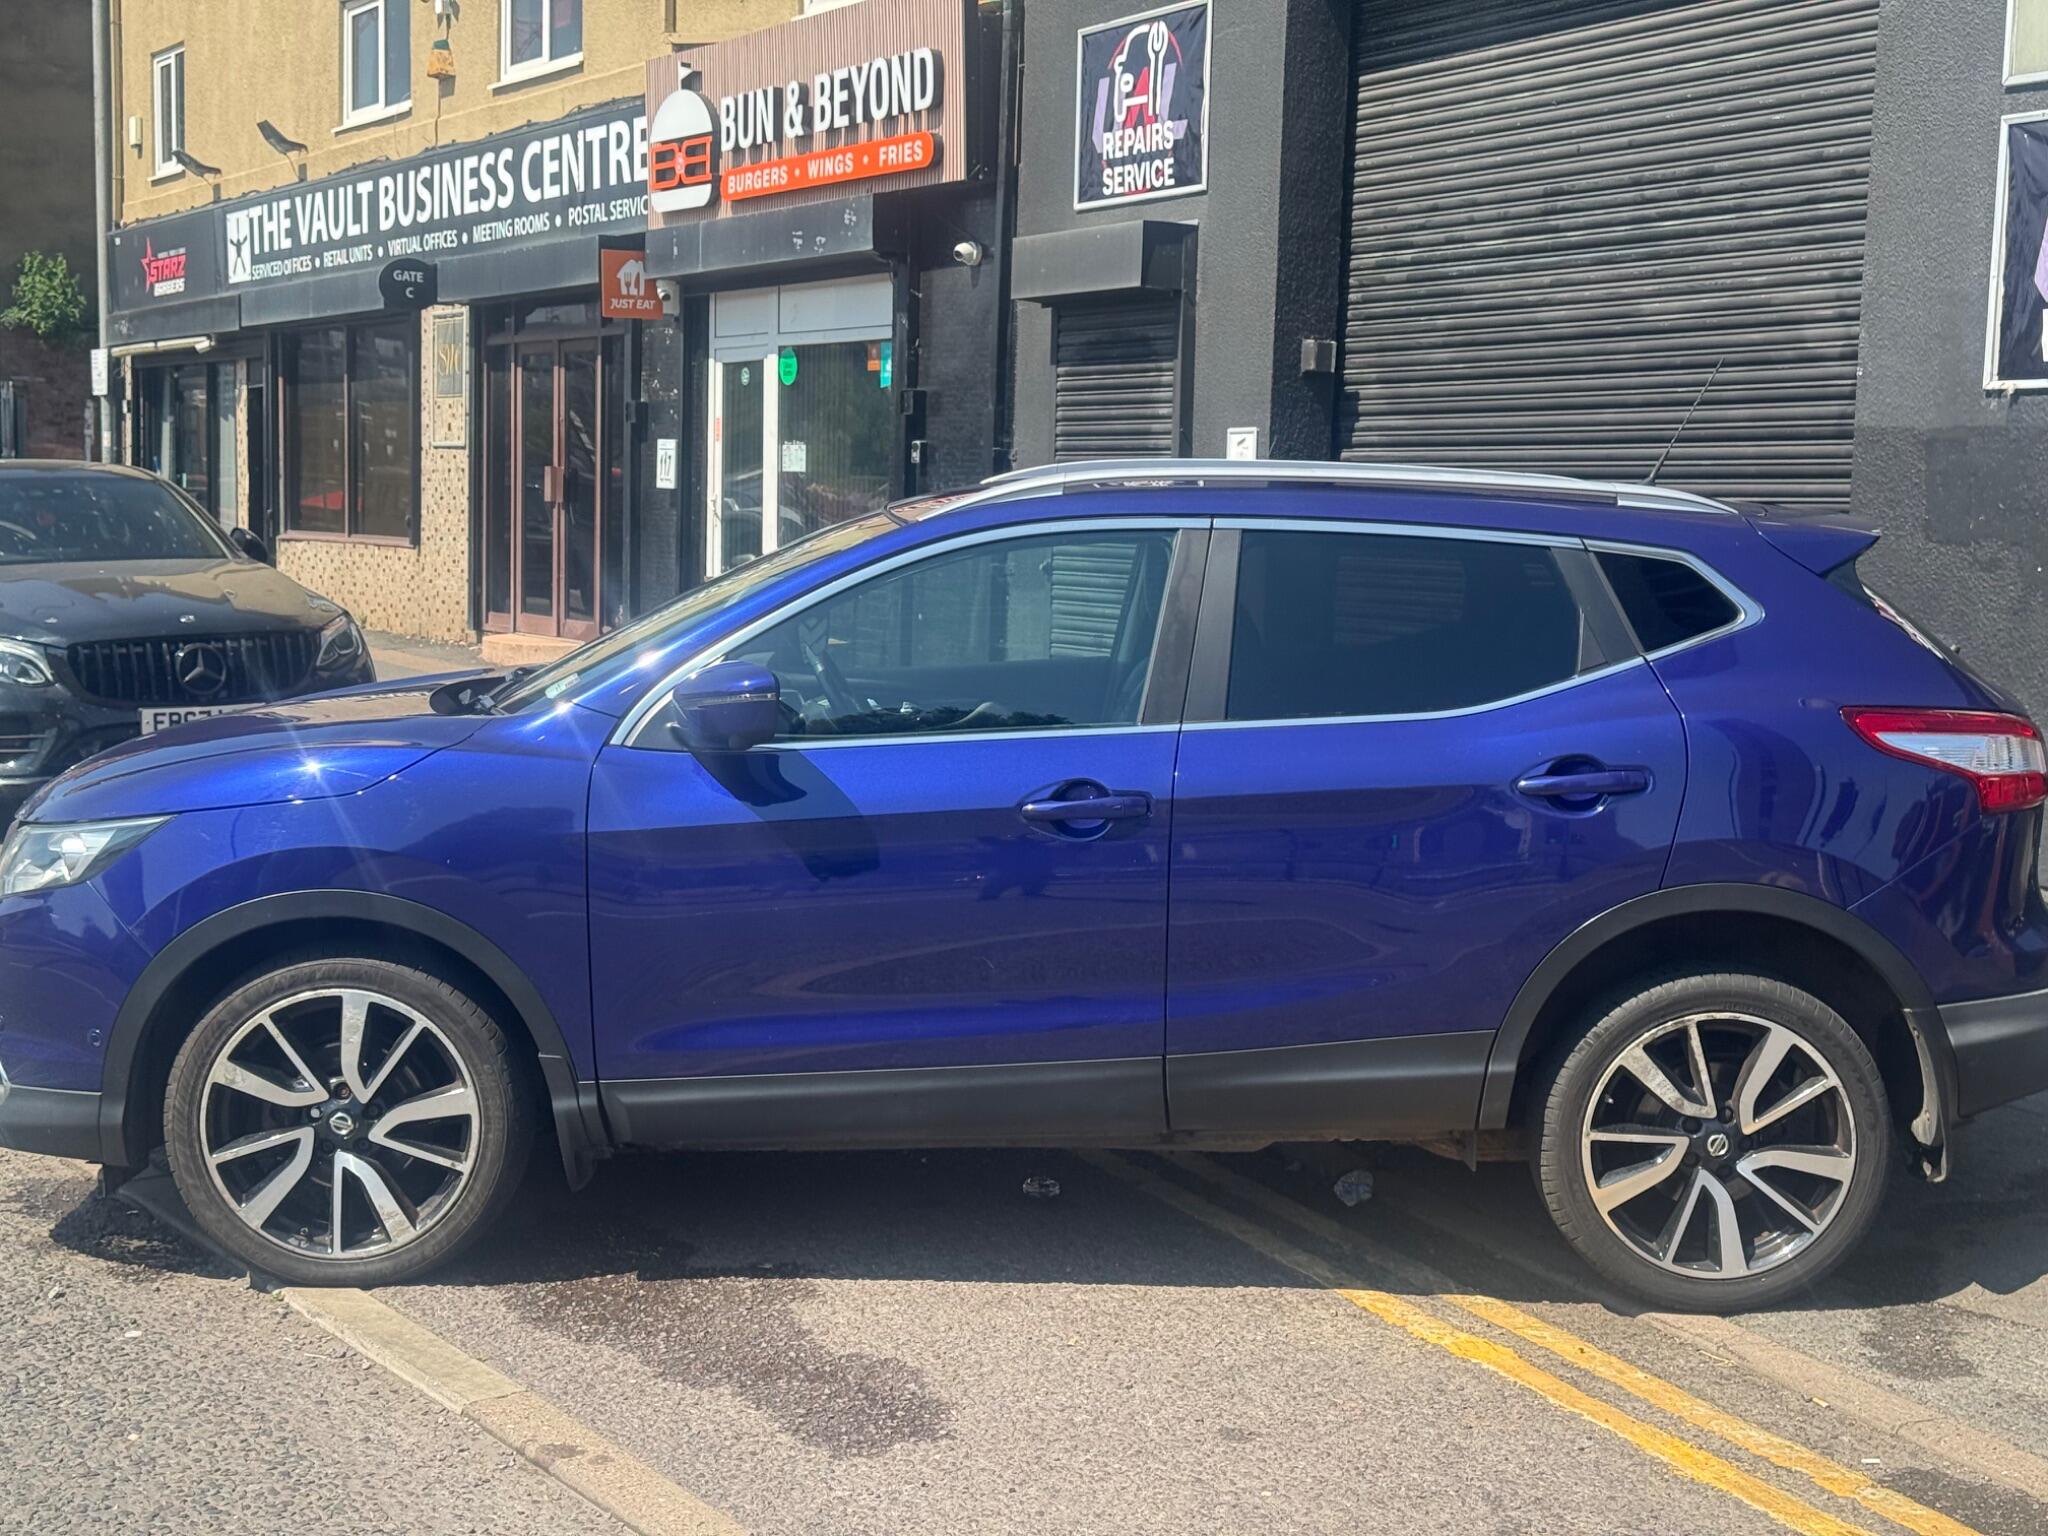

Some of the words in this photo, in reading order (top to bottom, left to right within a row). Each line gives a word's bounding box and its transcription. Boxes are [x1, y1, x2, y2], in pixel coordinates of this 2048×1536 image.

[720, 85, 775, 152] BUN
[784, 80, 805, 138] &
[814, 47, 935, 132] BEYOND
[1102, 120, 1175, 161] REPAIRS
[248, 199, 292, 255] THE
[295, 180, 374, 245] VAULT
[379, 147, 515, 231] BUSINESS
[521, 116, 647, 203] CENTRE
[727, 168, 788, 194] BURGERS
[807, 152, 854, 179] WINGS
[879, 140, 924, 167] FRIES
[1102, 157, 1175, 196] SERVICE
[252, 260, 283, 280] SERVICED
[323, 247, 349, 268] RETAIL
[349, 243, 374, 264] UNITS
[387, 235, 423, 257] VIRTUAL
[423, 229, 458, 252] OFFICES
[472, 218, 513, 244] MEETING
[514, 212, 550, 237] ROOMS
[568, 203, 608, 227] POSTAL
[609, 195, 648, 221] SERVIC
[149, 254, 186, 284] STARZ
[392, 270, 425, 283] GATE
[405, 287, 415, 299] C
[609, 298, 635, 310] JUST
[636, 299, 656, 310] EAT
